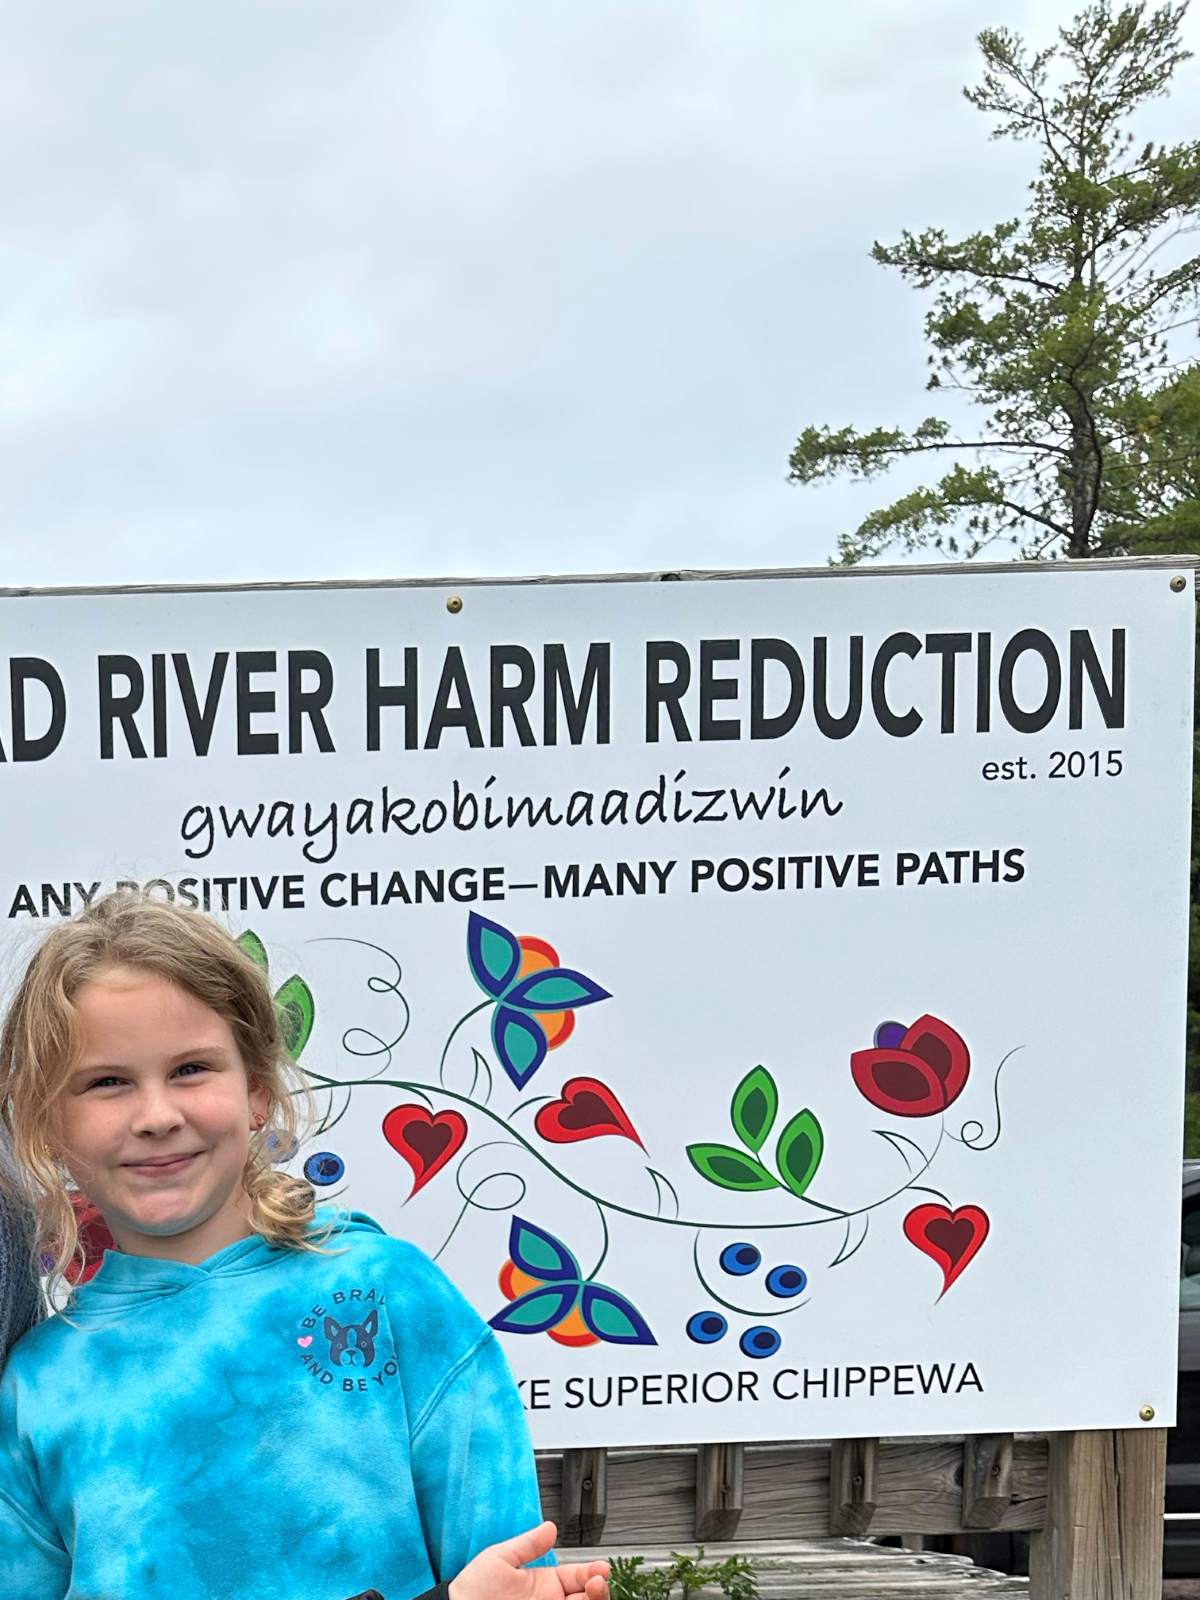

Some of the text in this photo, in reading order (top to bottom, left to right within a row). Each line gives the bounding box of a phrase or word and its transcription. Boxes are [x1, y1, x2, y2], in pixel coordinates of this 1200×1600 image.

[97, 650, 336, 760] RIVER
[365, 642, 611, 752] HARM
[645, 627, 1126, 744] REDUCTION
[982, 750, 1124, 781] est. 2015
[8, 881, 101, 919] ANY
[691, 853, 880, 893] POSITIVE
[896, 848, 1026, 886] PATHS
[302, 1304, 327, 1330] BE
[301, 1353, 398, 1392] AND BE YO
[564, 1370, 760, 1409] SUPERIOR
[772, 1362, 984, 1401] CHIPPEWA
